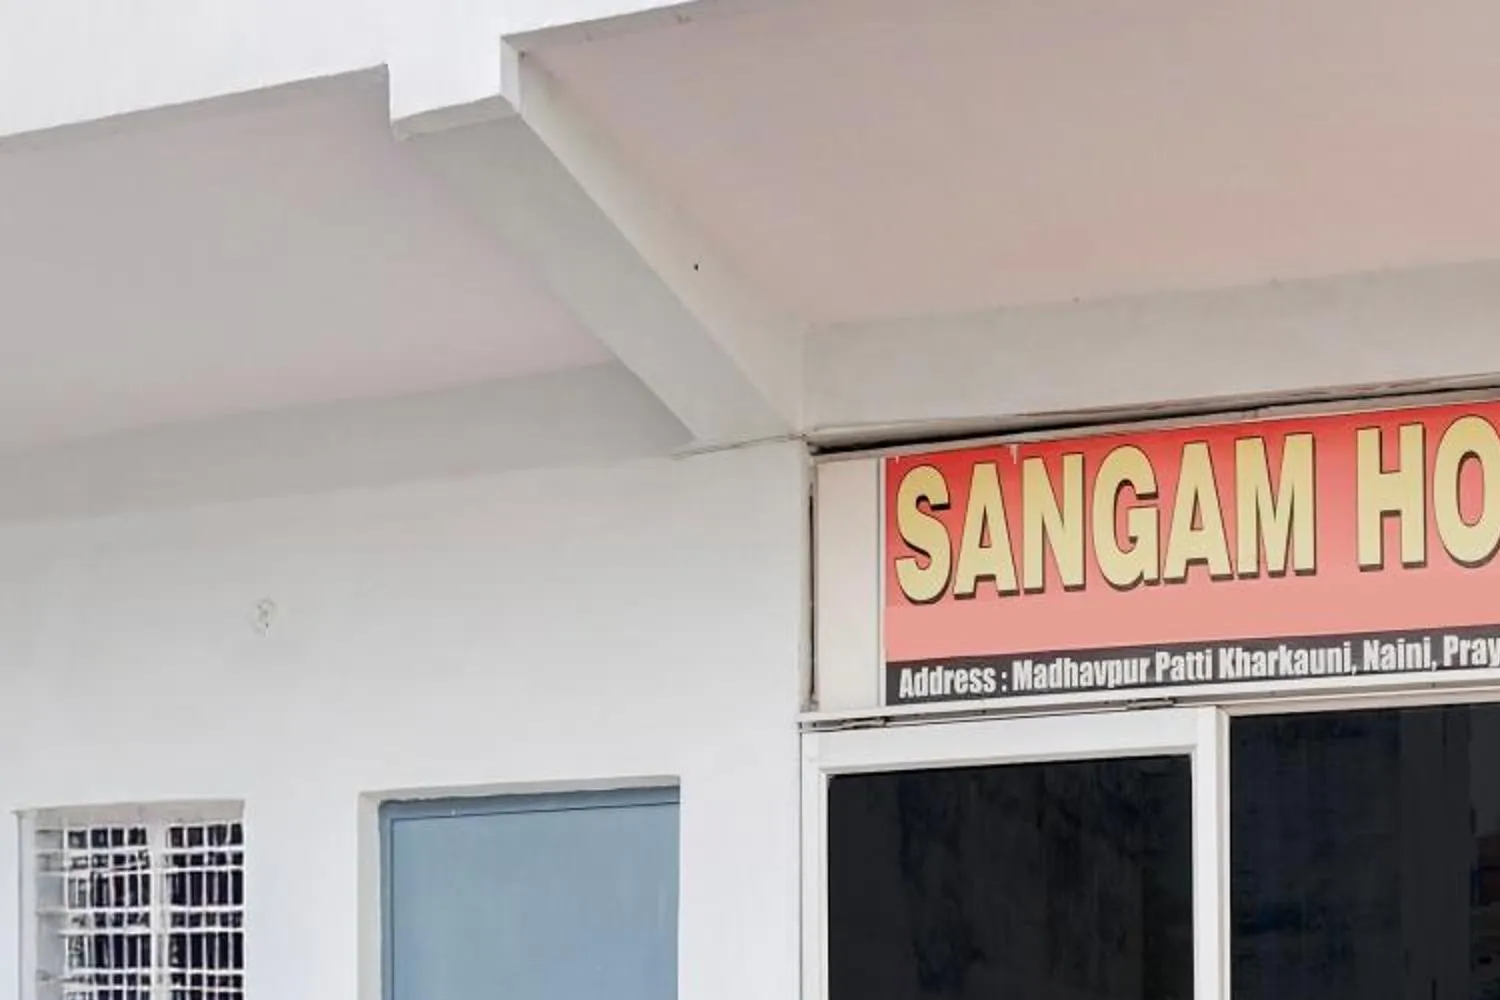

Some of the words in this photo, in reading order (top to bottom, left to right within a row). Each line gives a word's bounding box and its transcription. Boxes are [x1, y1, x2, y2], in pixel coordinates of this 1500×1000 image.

[895, 431, 1317, 604] SANGAM
[1012, 657, 1150, 690] Madhavpur
[1155, 648, 1213, 682] Patti
[1218, 642, 1357, 676] Kharkauni,
[1363, 637, 1437, 672] Naini,
